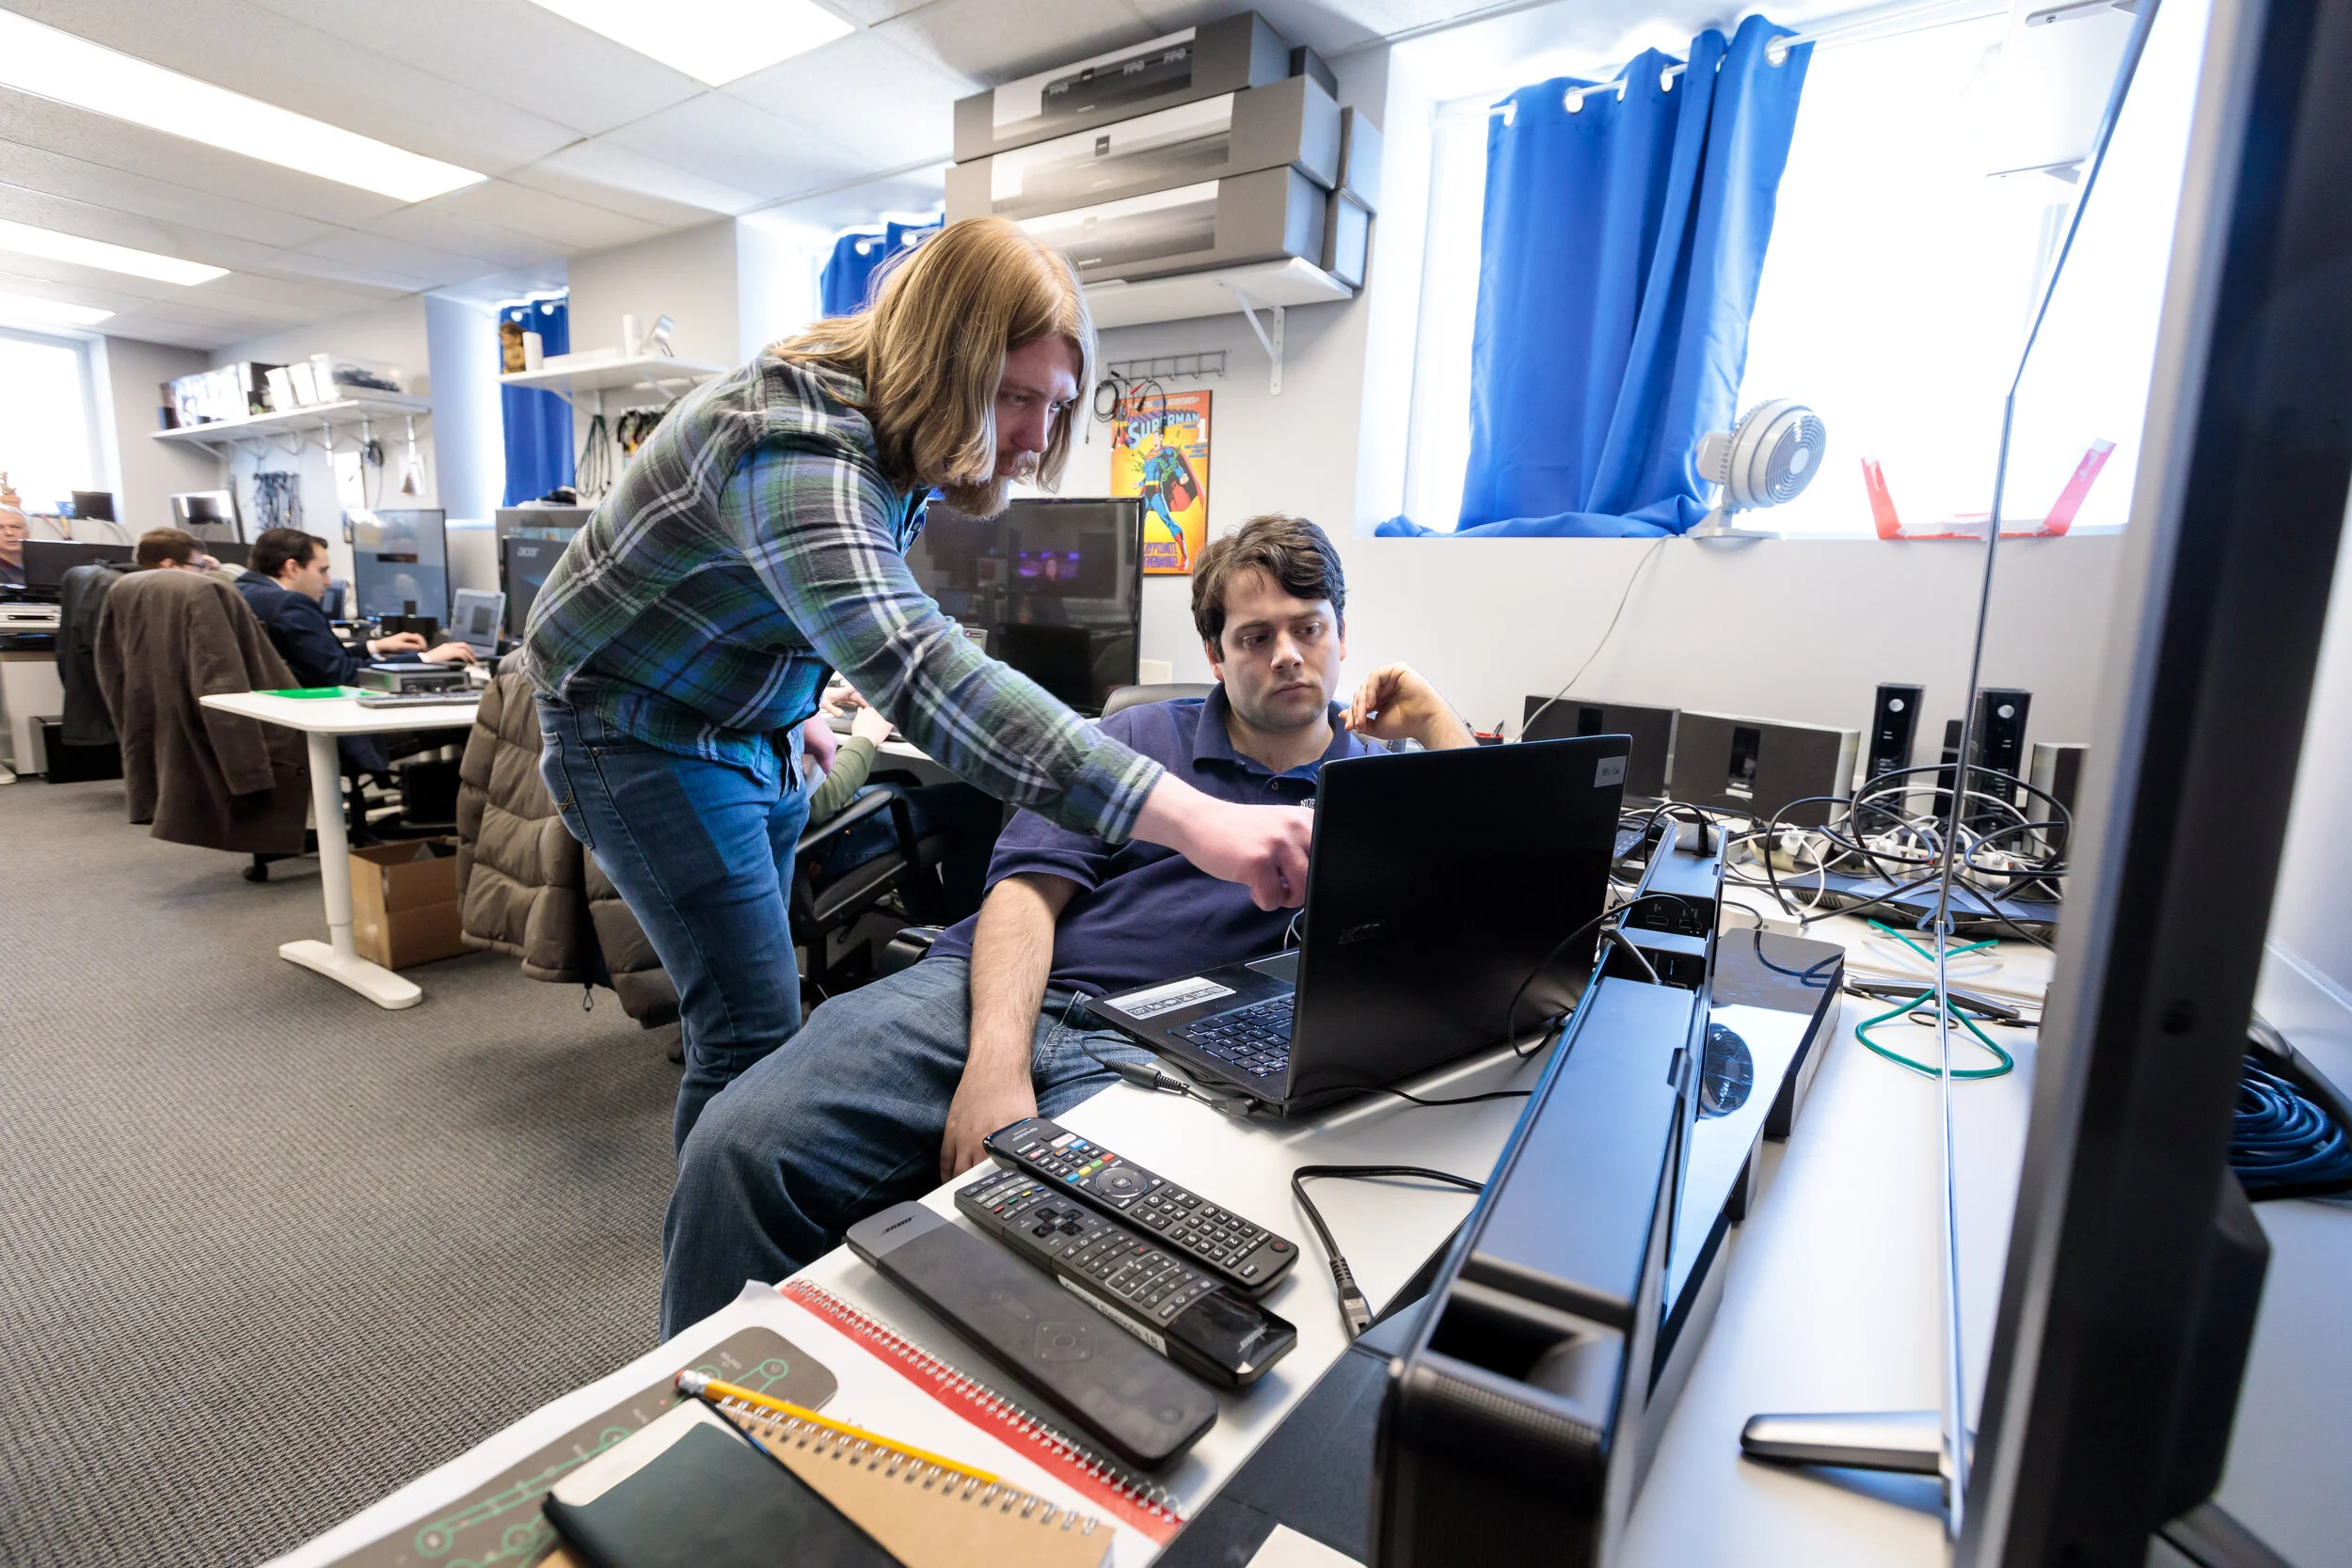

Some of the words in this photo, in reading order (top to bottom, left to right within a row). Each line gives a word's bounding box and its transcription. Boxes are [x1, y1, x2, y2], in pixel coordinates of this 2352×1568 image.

[1196, 418, 1208, 443] 1
[516, 546, 540, 558] acer
[1012, 1127, 1038, 1142] SHARP
